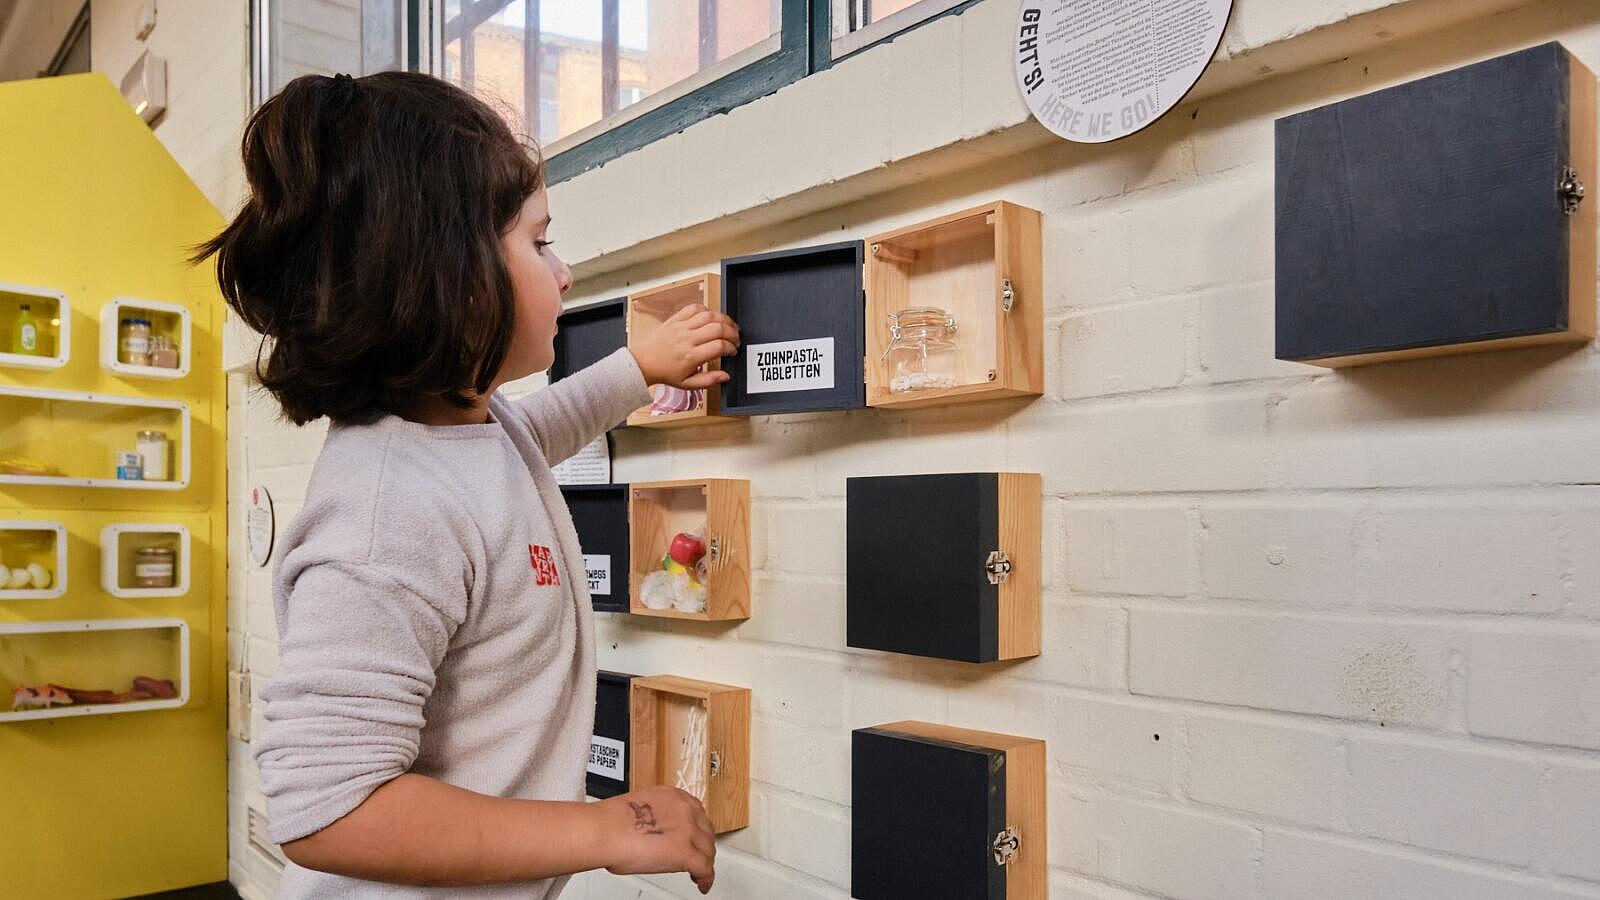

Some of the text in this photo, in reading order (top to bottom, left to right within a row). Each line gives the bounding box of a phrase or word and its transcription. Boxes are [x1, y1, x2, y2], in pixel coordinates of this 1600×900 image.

[1018, 9, 1045, 95] GEHT'S!
[1038, 94, 1157, 138] HERE WE GO!
[760, 363, 820, 382] TABLeTTeN
